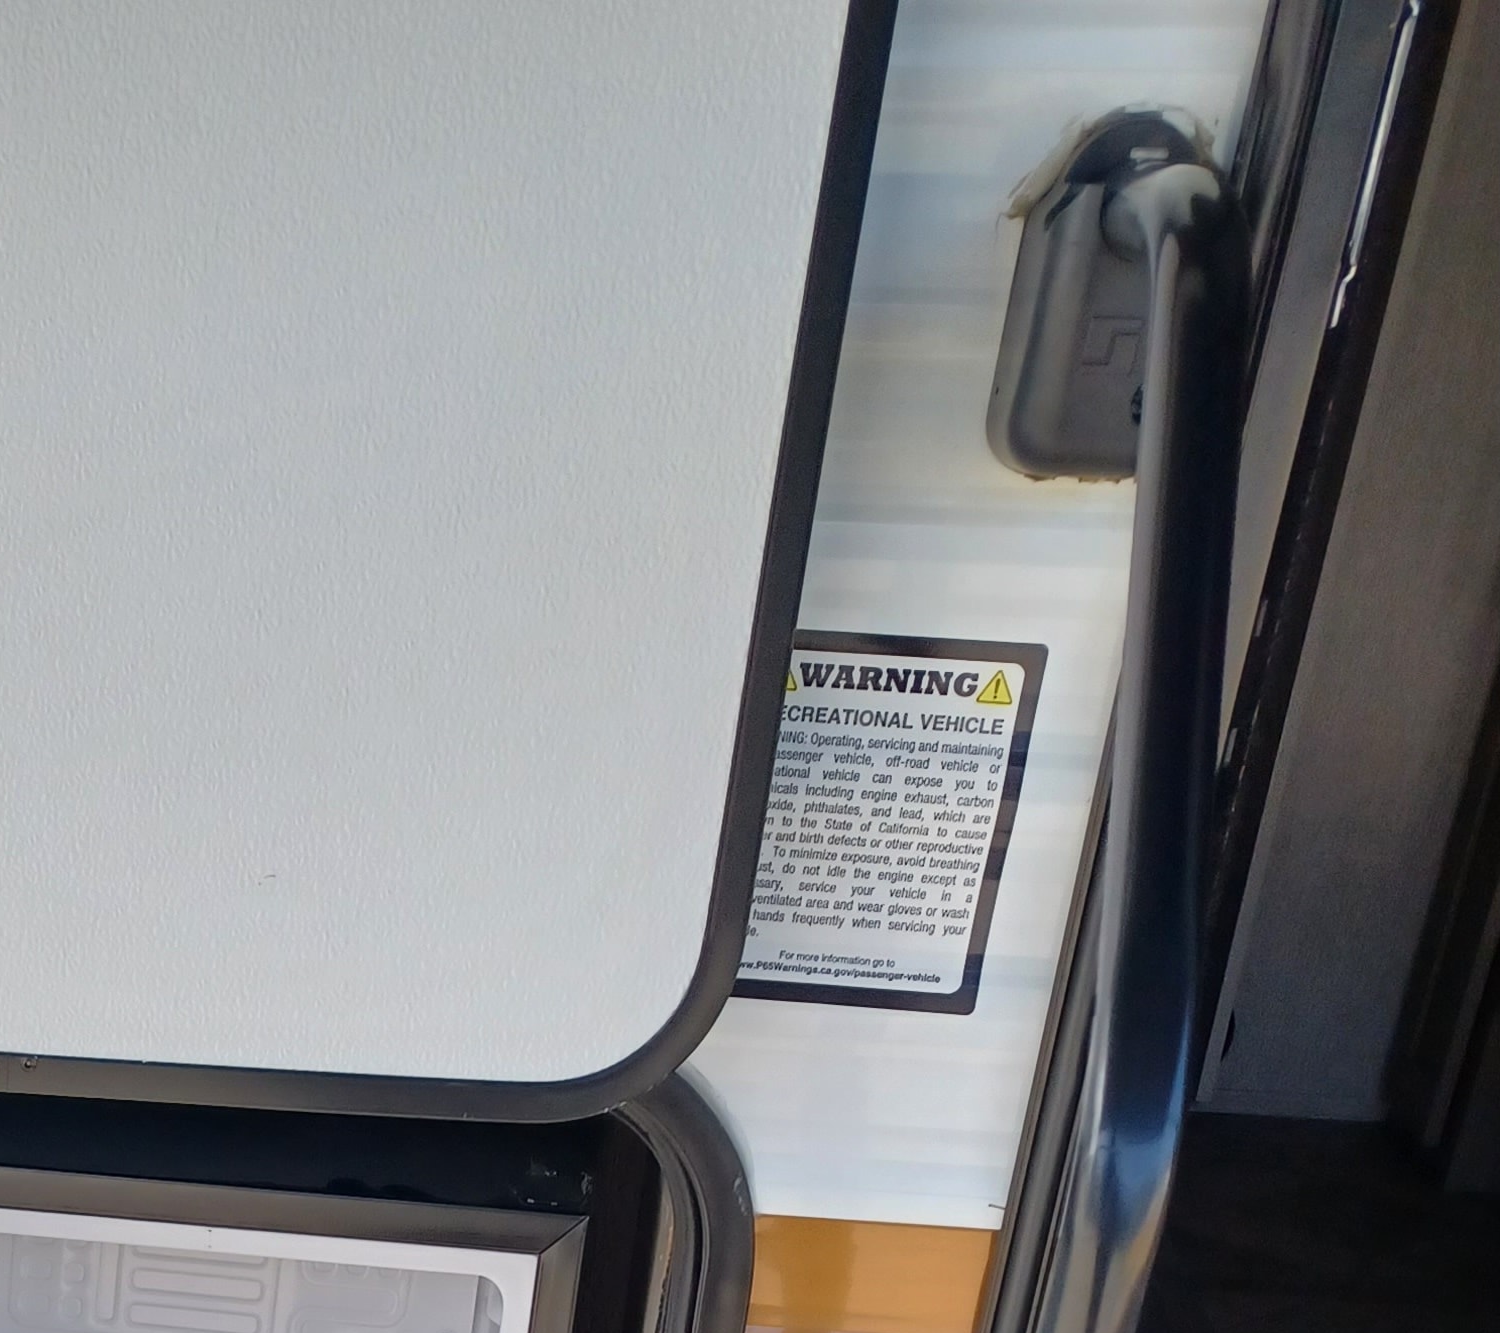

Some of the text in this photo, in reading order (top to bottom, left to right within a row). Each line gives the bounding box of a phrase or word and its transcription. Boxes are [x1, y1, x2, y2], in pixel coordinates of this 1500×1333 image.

[800, 662, 979, 697] WARNING
[921, 714, 1004, 735] VEHICLE
[811, 733, 865, 750] Operating,
[868, 738, 915, 753] servicing
[918, 741, 939, 752] and
[941, 742, 1004, 760] maintaining
[834, 752, 875, 767] vehicle,
[886, 755, 930, 769] off-road
[941, 760, 979, 773] vehicle
[989, 764, 1001, 774] or
[775, 766, 998, 791] ational vehicle can expose you to
[805, 784, 854, 801] including
[861, 789, 897, 803] engine
[904, 792, 949, 807] exhaust,
[957, 796, 994, 808] carbon
[803, 801, 862, 817] phthalates,
[871, 806, 892, 818] and
[899, 807, 924, 822] lead,
[933, 810, 966, 823] which
[973, 814, 991, 824] are
[782, 816, 792, 827] to
[800, 817, 817, 829] the
[824, 818, 853, 831] State
[860, 821, 872, 832] of
[878, 822, 929, 836] California
[937, 827, 948, 837] to
[955, 830, 987, 840] cause
[775, 832, 796, 843] and
[799, 832, 824, 844] birth
[828, 834, 866, 848] defects
[870, 839, 882, 848] or
[885, 839, 913, 851] other
[916, 841, 983, 855] reproductive
[773, 846, 980, 873] To minimize exposure, avoid breathing
[782, 863, 796, 874] do
[803, 865, 820, 876] not
[827, 865, 846, 877] idle
[854, 867, 871, 879] the
[878, 870, 913, 884] engine
[921, 874, 956, 887] except
[963, 877, 976, 887] as
[799, 881, 836, 893] service
[851, 885, 875, 897] your
[889, 887, 926, 900] vehicle
[941, 890, 951, 901] in
[965, 894, 973, 903] a
[806, 899, 829, 909] area
[833, 899, 853, 911] and
[858, 902, 884, 913] wear
[888, 903, 922, 916] gloves
[926, 907, 937, 917] or
[941, 908, 969, 919] wash
[752, 909, 967, 936] hands frequently when servicing your
[779, 950, 895, 968] For more information go to
